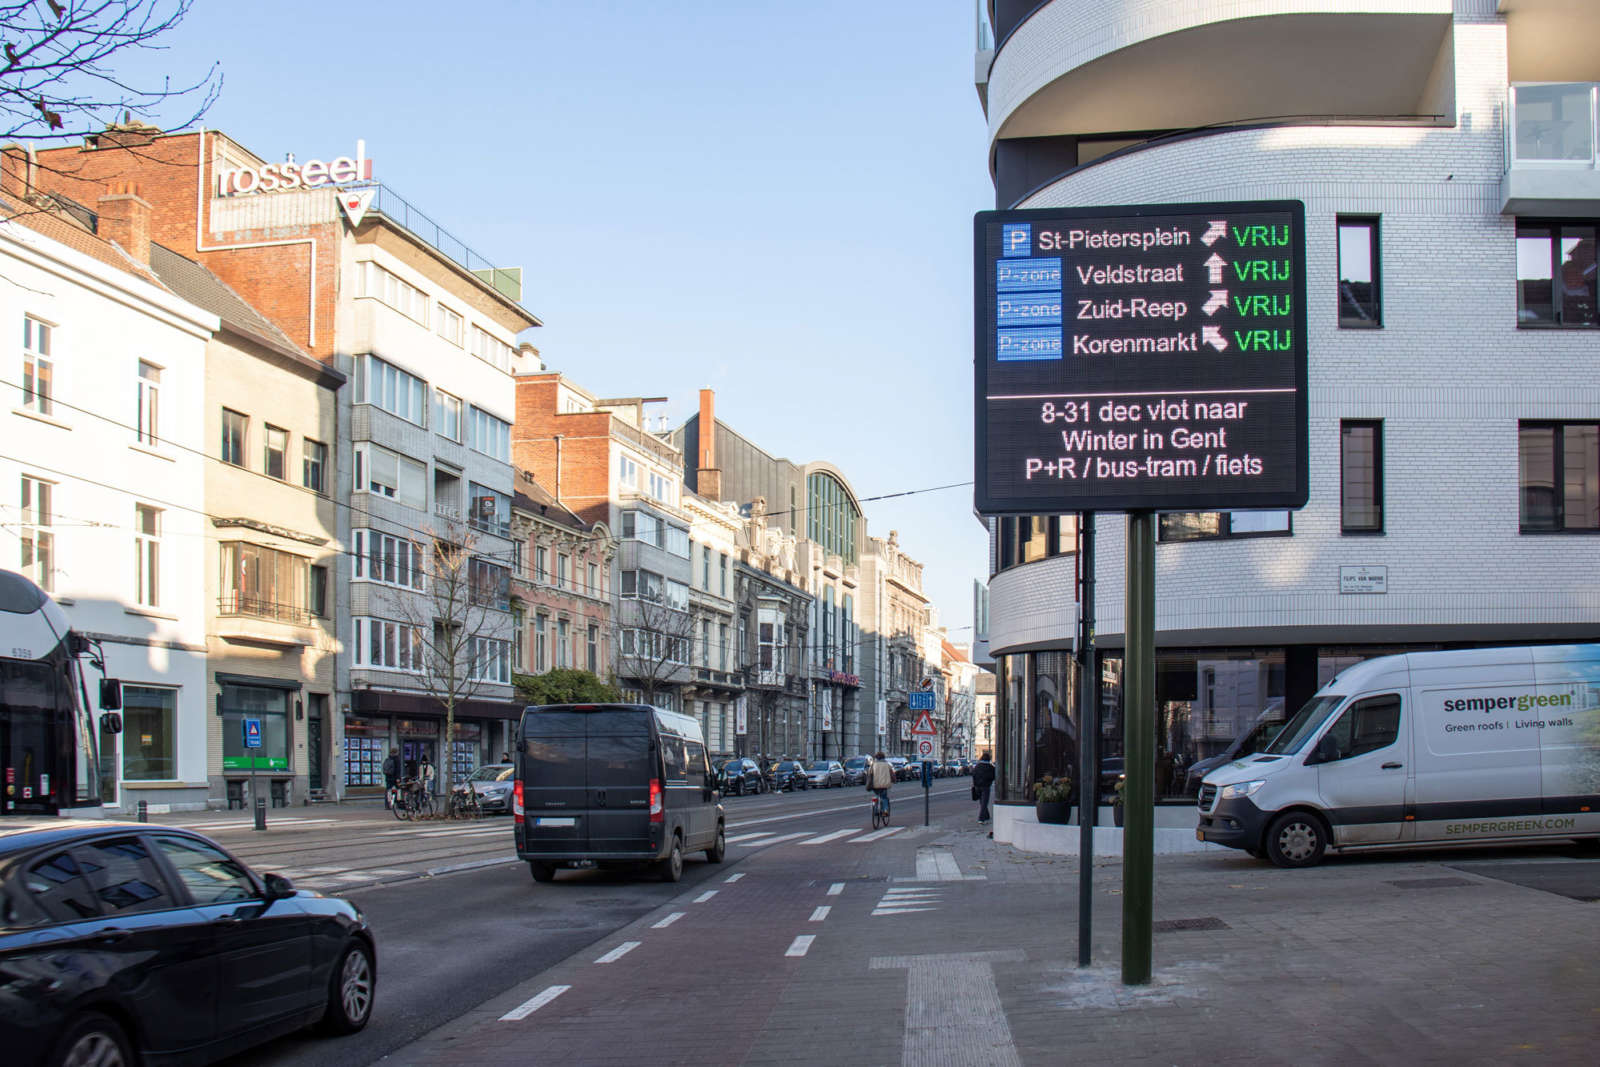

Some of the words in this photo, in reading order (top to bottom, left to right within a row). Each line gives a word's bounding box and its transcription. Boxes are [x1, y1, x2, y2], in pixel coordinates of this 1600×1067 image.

[219, 139, 365, 197] rosseel
[1011, 230, 1027, 250] P
[1039, 227, 1191, 251] St-Pietersplein
[1232, 225, 1289, 247] VRIJ
[999, 267, 1061, 282] P-zone
[1076, 263, 1184, 285] Veldstraat
[1233, 260, 1290, 281] VRIJ
[1000, 301, 1061, 318] P-zone
[1077, 298, 1188, 321] Zuid-Reep
[1234, 294, 1291, 316] VRIJ
[1000, 335, 1062, 352] P-zone
[1073, 332, 1198, 354] Korenmarkt
[1234, 329, 1291, 351] VRIJ
[1041, 401, 1090, 423] 8-31
[1098, 400, 1142, 422] dec
[1148, 399, 1190, 421] vlot
[1195, 401, 1248, 420] naar
[1061, 430, 1137, 451] Winter
[1143, 429, 1163, 450] in
[1170, 427, 1227, 449] Gent
[1025, 457, 1077, 480] P+R
[1082, 458, 1092, 478] /
[1096, 456, 1197, 478] bus-tram
[1202, 454, 1211, 476] /
[1215, 454, 1263, 476] fiets
[1443, 693, 1571, 713] sempergreen
[1445, 723, 1475, 733] Green
[1478, 721, 1504, 730] roofs
[1515, 719, 1545, 729] Living
[1548, 717, 1574, 727] walls
[1446, 818, 1575, 835] SEMPERGREEN.COM
